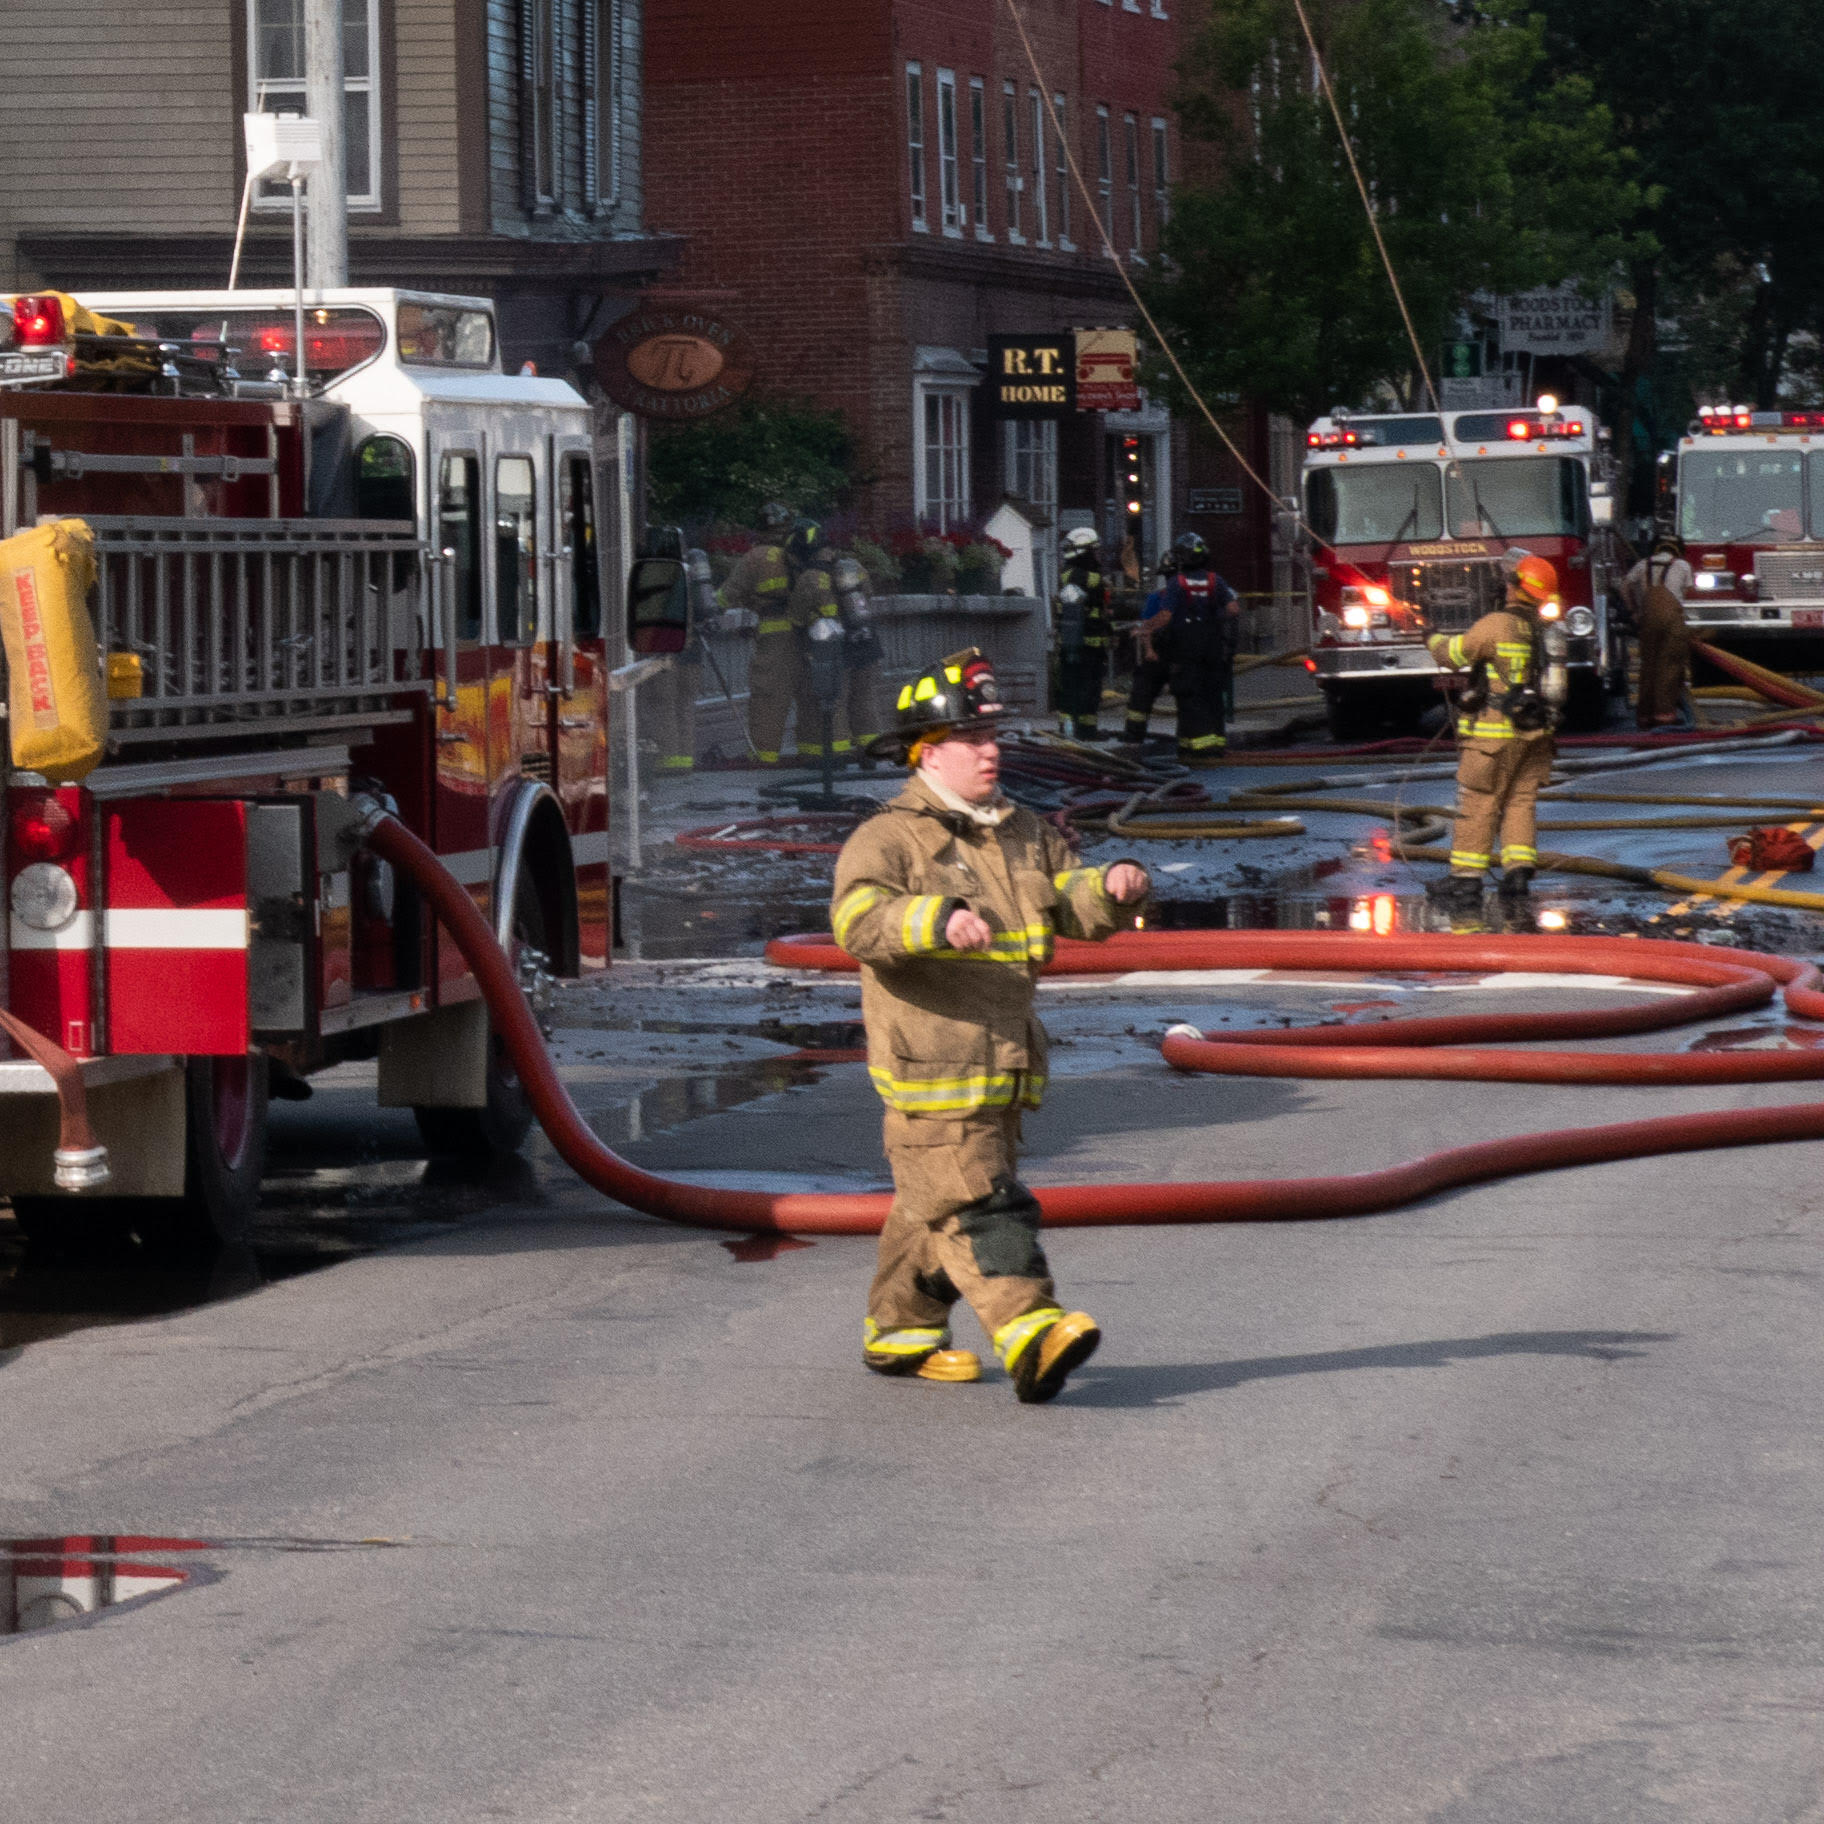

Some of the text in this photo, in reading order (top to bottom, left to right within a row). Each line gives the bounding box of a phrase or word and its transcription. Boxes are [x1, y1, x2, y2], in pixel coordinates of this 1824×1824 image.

[1510, 314, 1602, 331] PHARMACY
[1003, 348, 1064, 375] R.T.
[1000, 385, 1067, 402] HOME
